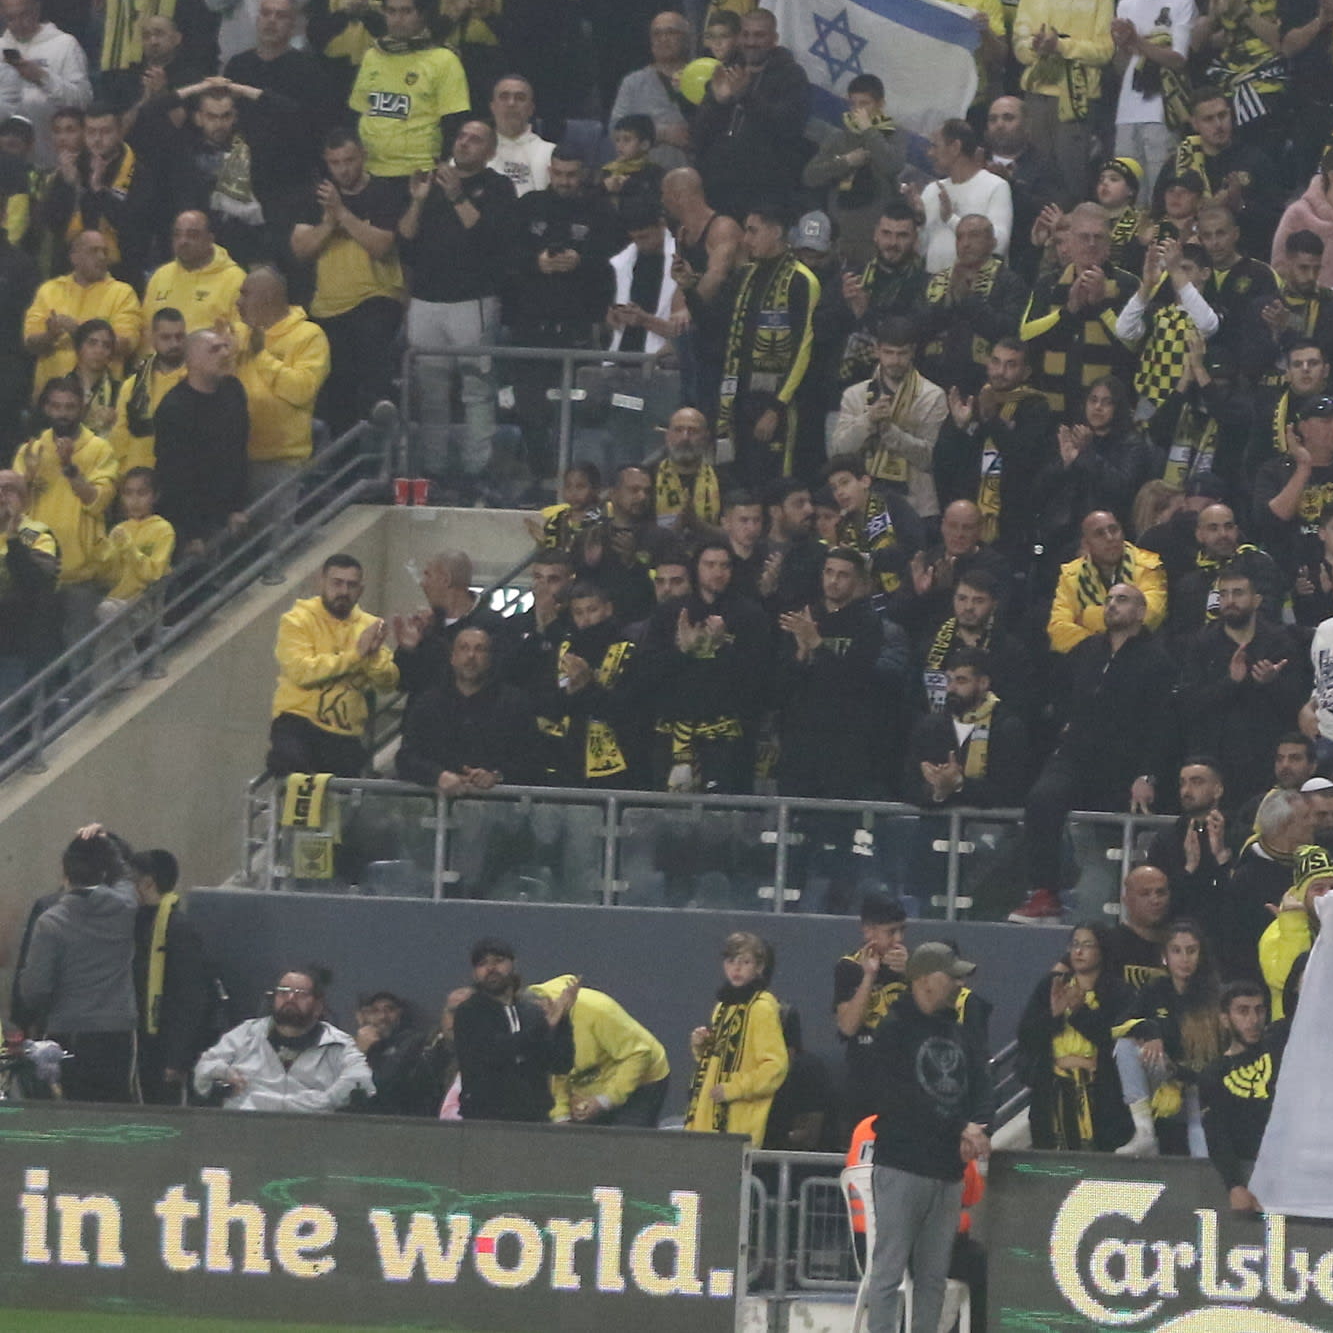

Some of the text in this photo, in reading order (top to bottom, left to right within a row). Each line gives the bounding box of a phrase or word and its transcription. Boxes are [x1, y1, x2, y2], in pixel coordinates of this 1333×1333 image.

[20, 1167, 734, 1298] in the world.
